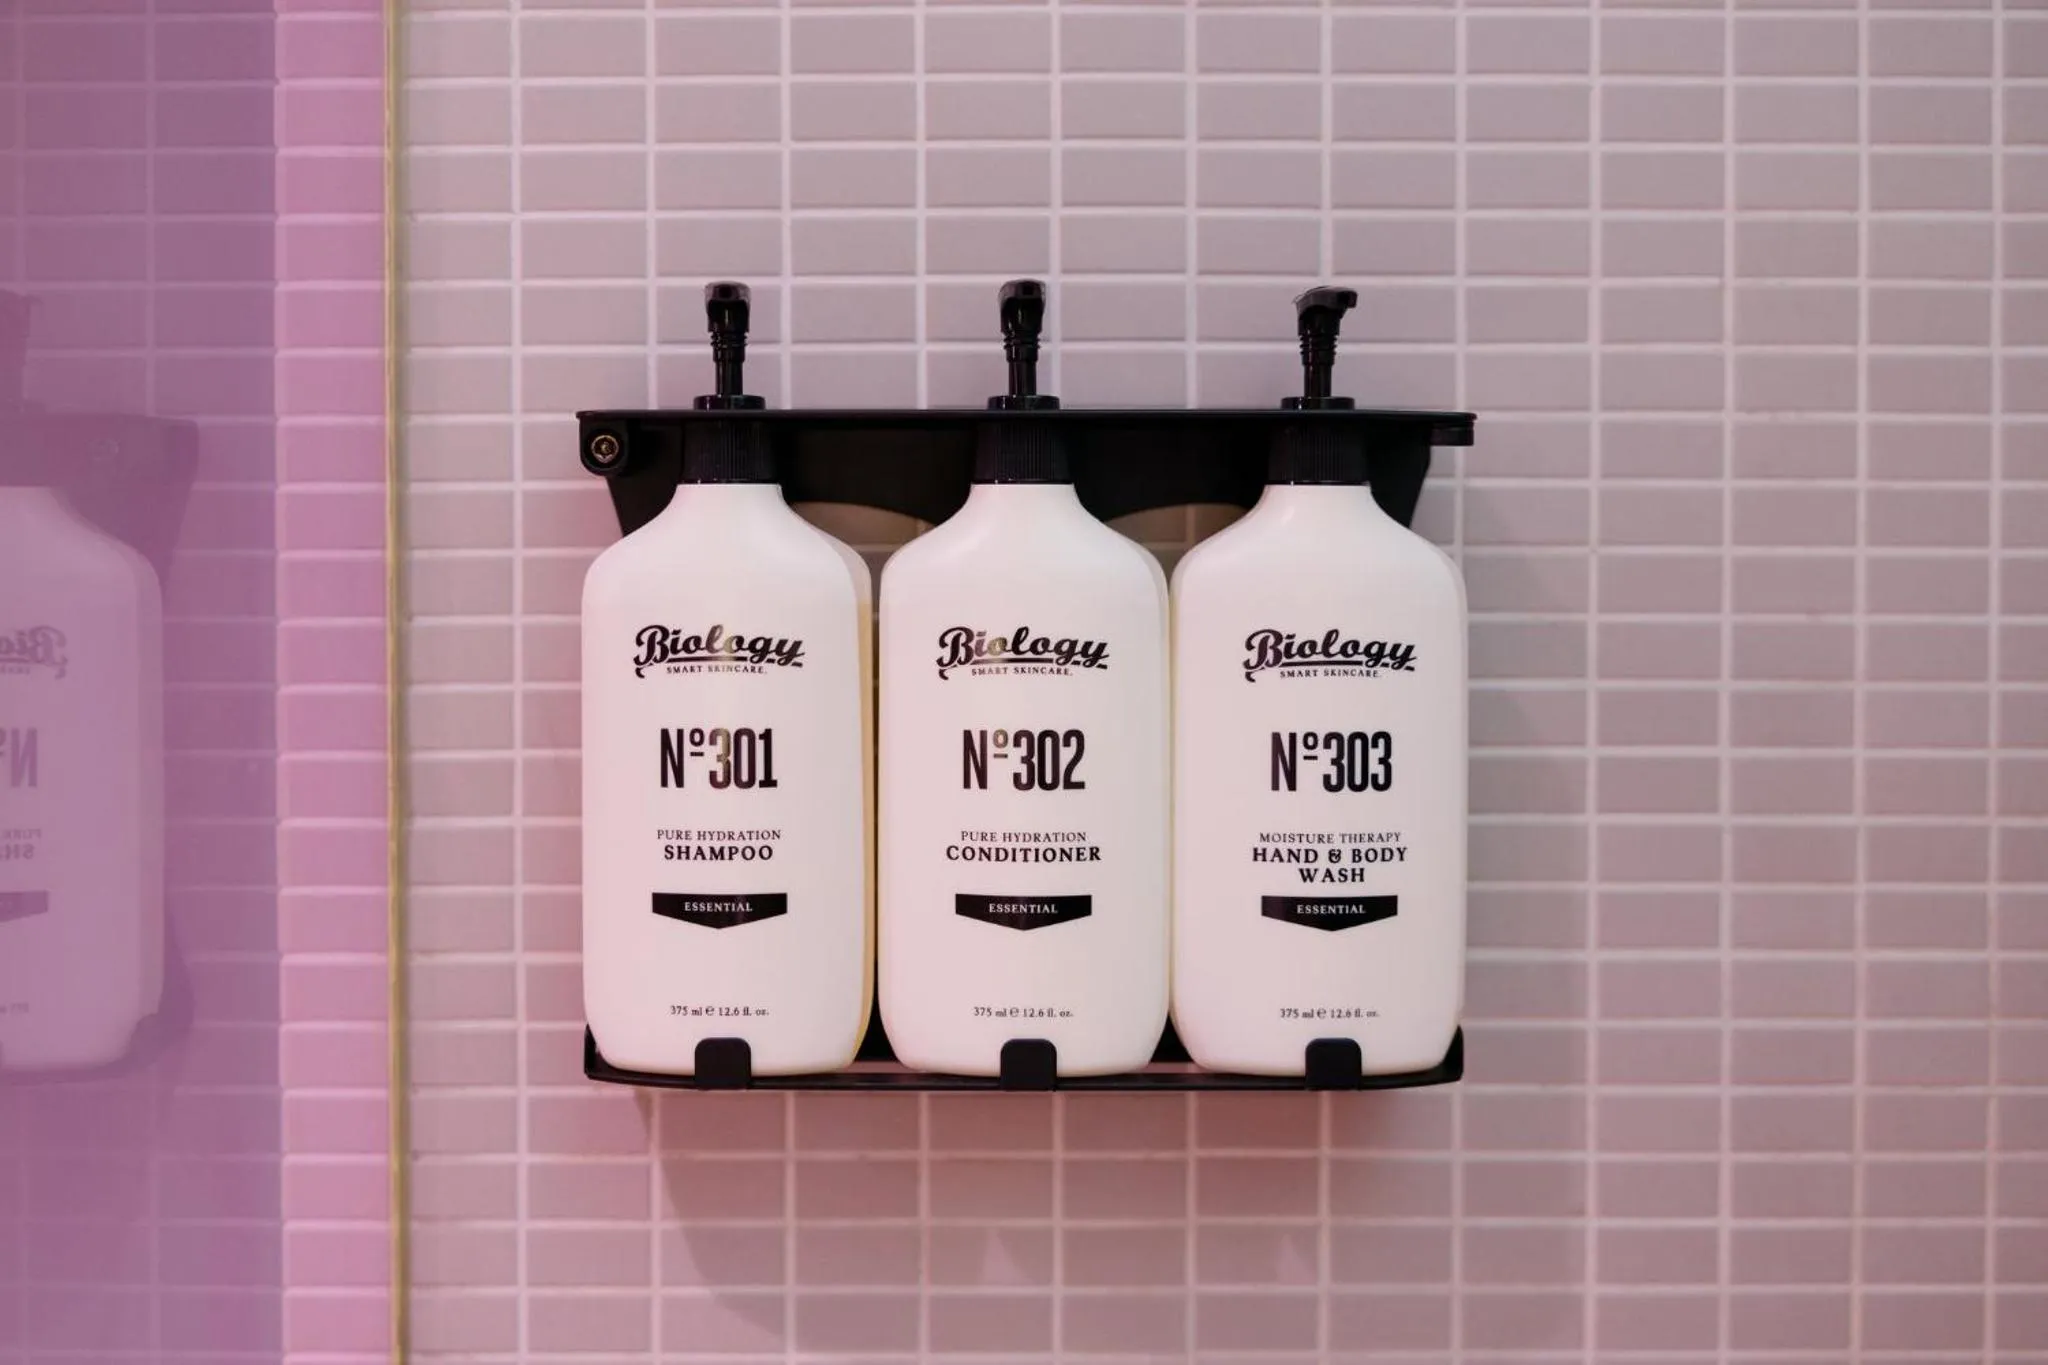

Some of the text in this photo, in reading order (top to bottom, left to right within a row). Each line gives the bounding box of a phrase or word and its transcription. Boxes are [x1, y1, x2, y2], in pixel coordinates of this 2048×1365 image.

[633, 625, 805, 679] Biology
[936, 626, 1109, 680] Biology
[1243, 629, 1417, 683] Biology
[667, 665, 702, 673] SMART
[972, 667, 1008, 676] SMART
[1280, 669, 1318, 678] SMART
[657, 830, 780, 841] PURE HYDRATION
[961, 831, 1086, 842] PURE HYDRATION
[1260, 832, 1400, 844] MOISTURE THERAPY
[665, 845, 773, 861] SHAMPOO
[946, 845, 1101, 863] CONDITIONER
[1253, 847, 1407, 864] HAND & BODY
[1299, 868, 1365, 883] WASH
[685, 902, 752, 912] ESSENTIAL
[989, 904, 1057, 913] ESSENTIAL
[1297, 904, 1365, 914] ESSENTIAL
[671, 1005, 688, 1016] 375
[692, 1007, 702, 1016] ml
[719, 1007, 740, 1016] 12.6
[974, 1007, 992, 1017] 375
[995, 1008, 1008, 1017] ml
[1024, 1008, 1044, 1017] 12.6
[1280, 1008, 1299, 1019] 375
[1302, 1008, 1314, 1018] ml
[1331, 1009, 1352, 1018] 12.6
